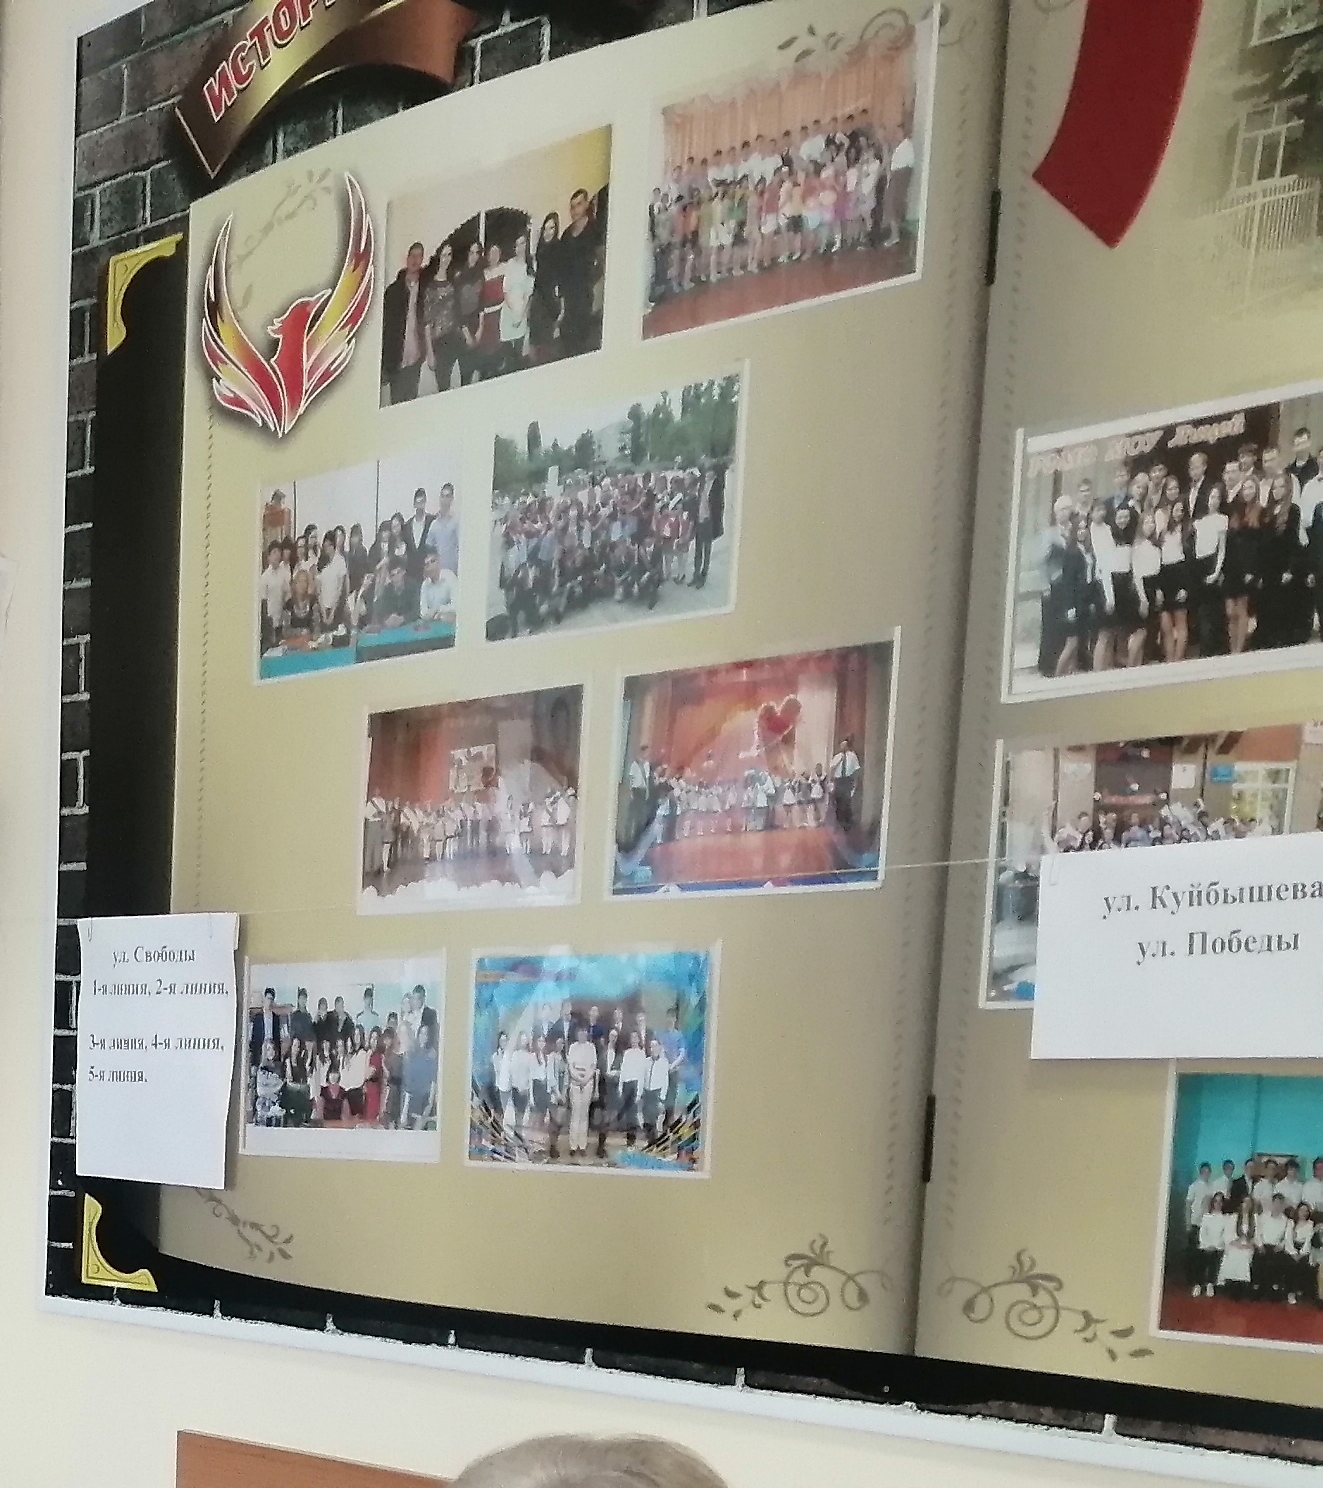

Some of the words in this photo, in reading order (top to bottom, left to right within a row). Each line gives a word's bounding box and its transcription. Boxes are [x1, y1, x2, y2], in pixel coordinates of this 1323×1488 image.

[203, 0, 336, 123] ИСТОР
[1102, 893, 1141, 920] ул.
[1150, 880, 1323, 915] Куйбышева
[112, 949, 129, 968] ул.
[133, 945, 196, 963] Свободы
[1136, 940, 1176, 966] ул.
[1187, 929, 1301, 957] Победы
[155, 978, 177, 996] 2-я
[180, 981, 230, 998] линия,
[89, 1034, 106, 1051] 3-я
[109, 1035, 147, 1052] линия,
[151, 1033, 171, 1050] 4-я
[174, 1035, 225, 1052] линия,
[88, 1065, 105, 1082] 5-я
[107, 1068, 148, 1083] линия.
